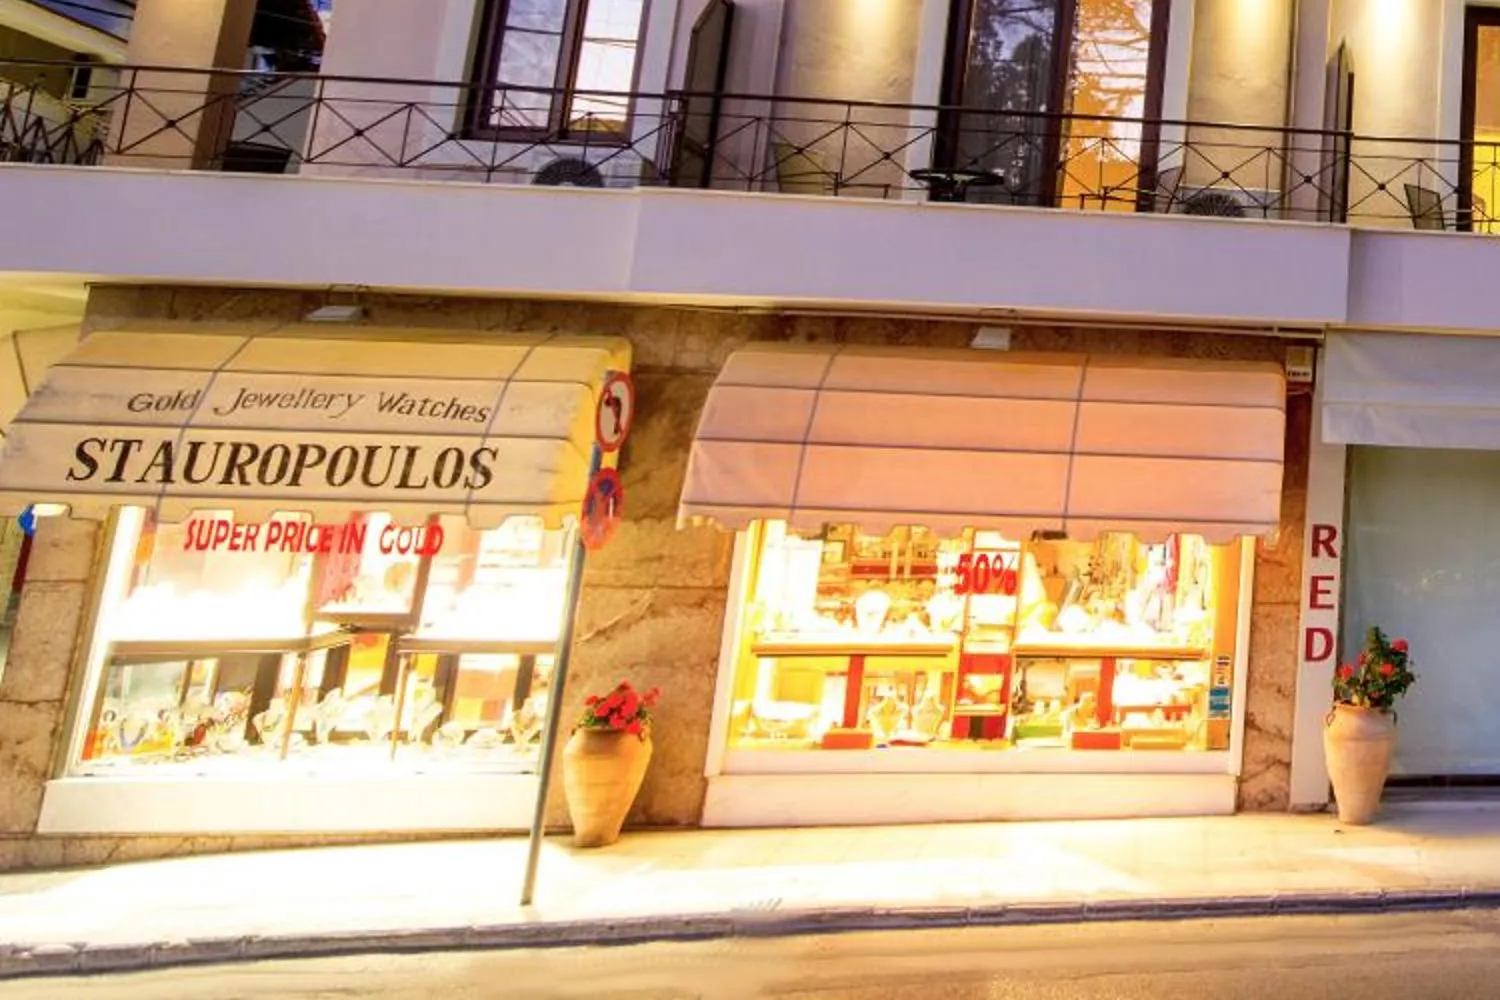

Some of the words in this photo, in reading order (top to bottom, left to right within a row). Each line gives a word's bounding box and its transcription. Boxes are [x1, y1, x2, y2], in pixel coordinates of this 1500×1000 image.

[127, 389, 201, 413] Gold
[213, 387, 366, 419] Jewellery
[377, 391, 492, 423] Watches
[66, 437, 499, 490] STAUROPOULOS
[184, 518, 260, 551] SUPER
[264, 520, 335, 554] PRICE
[338, 521, 367, 554] IN
[379, 524, 444, 556] GOLD
[954, 553, 1017, 596] 50%
[1304, 523, 1338, 663] RED
